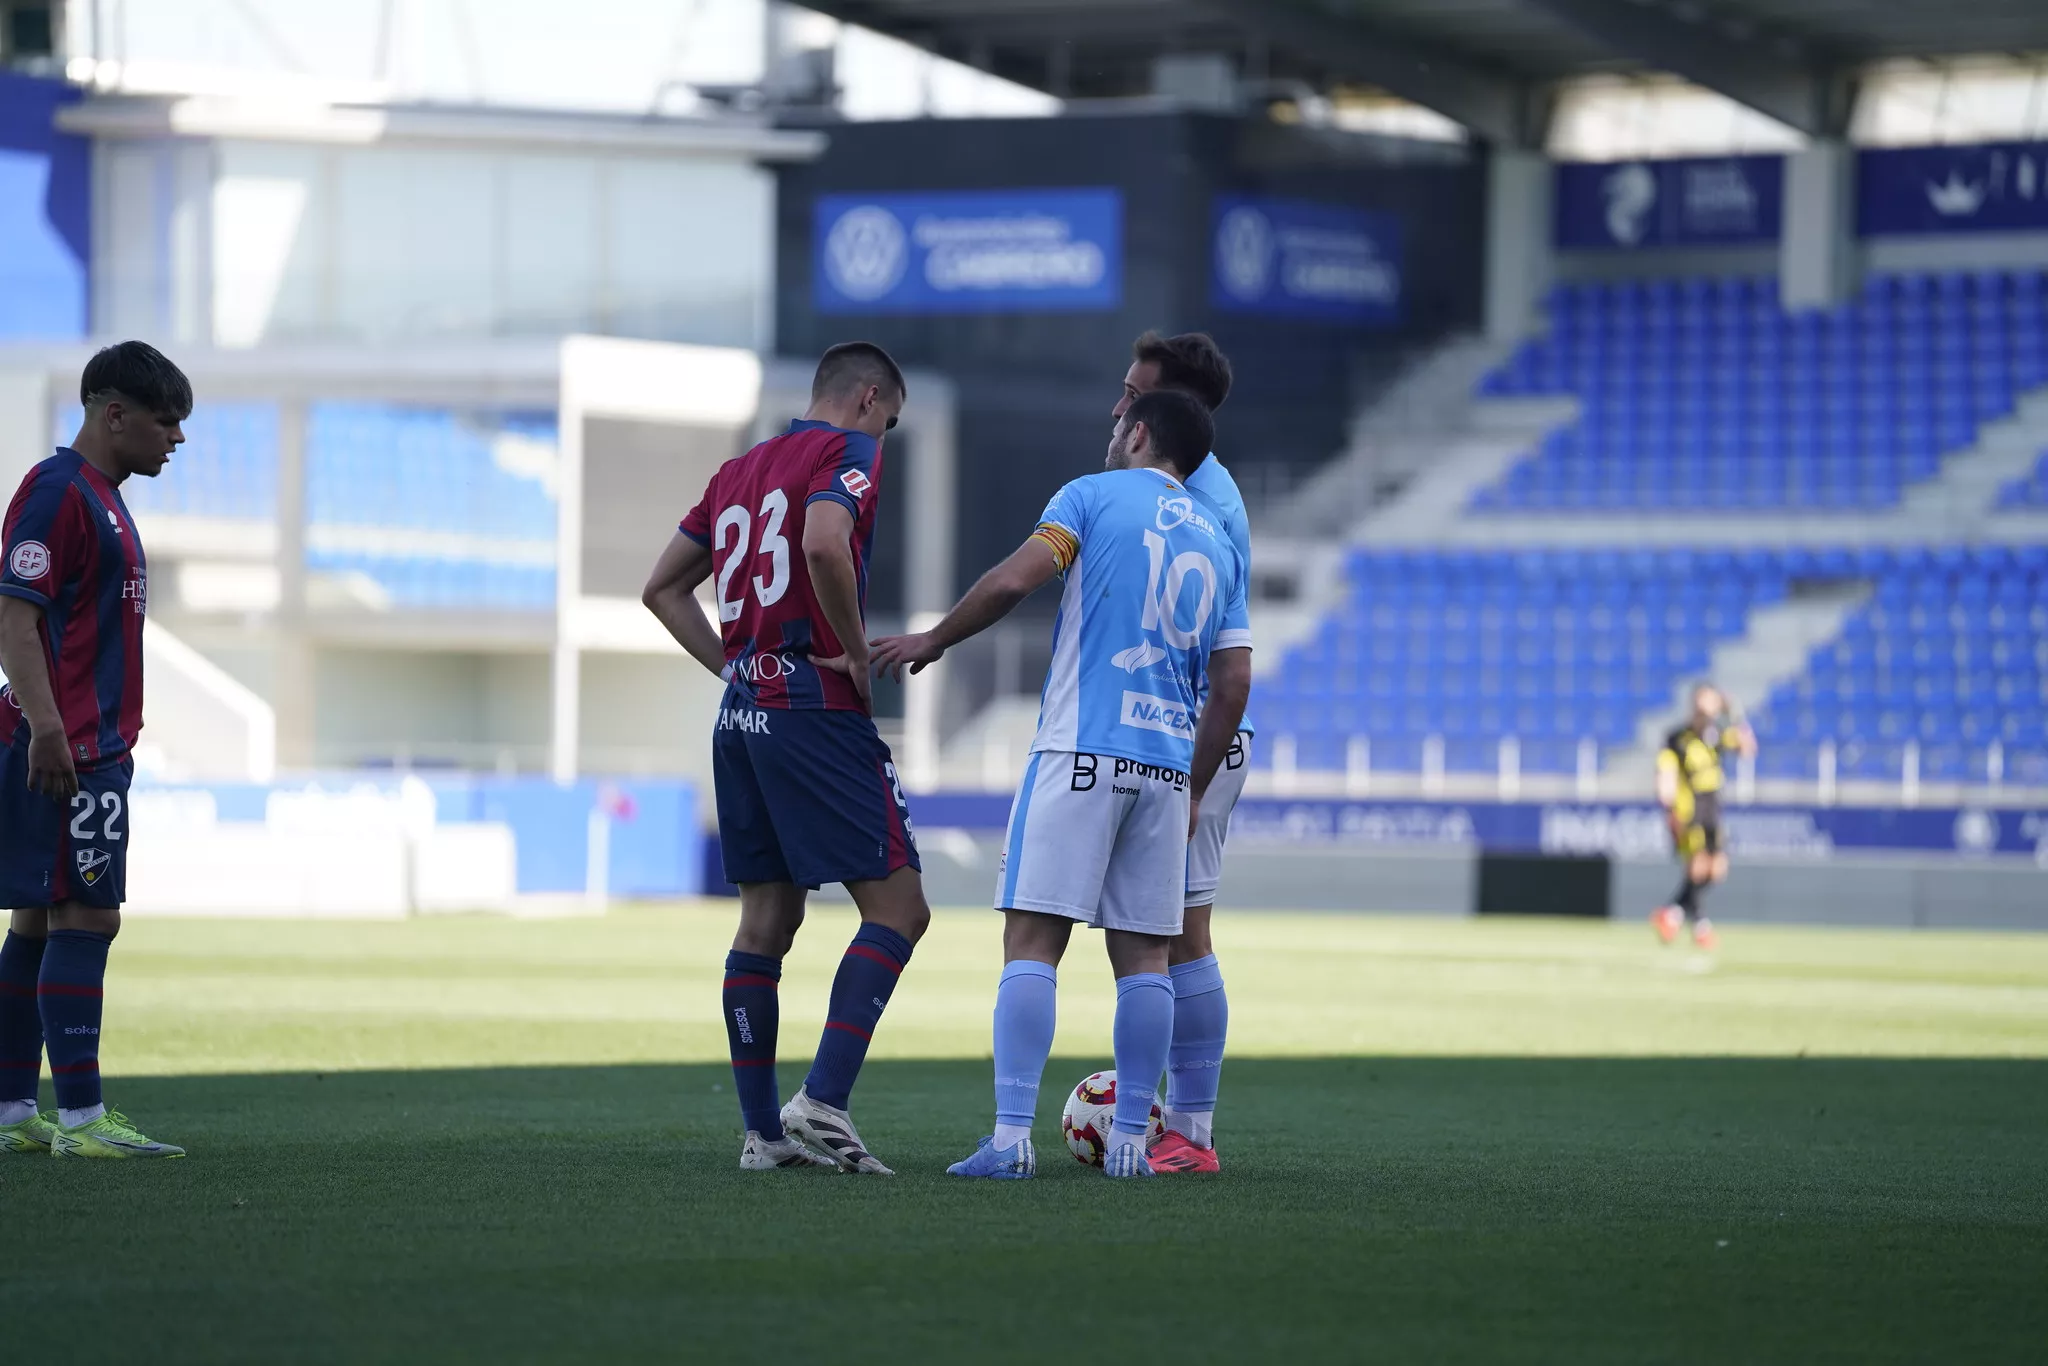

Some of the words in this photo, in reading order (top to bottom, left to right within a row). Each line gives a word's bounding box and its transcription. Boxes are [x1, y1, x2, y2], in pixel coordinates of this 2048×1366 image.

[714, 488, 790, 624] 23
[1142, 528, 1217, 650] 10
[70, 790, 122, 840] 22
[64, 1025, 99, 1035] soka
